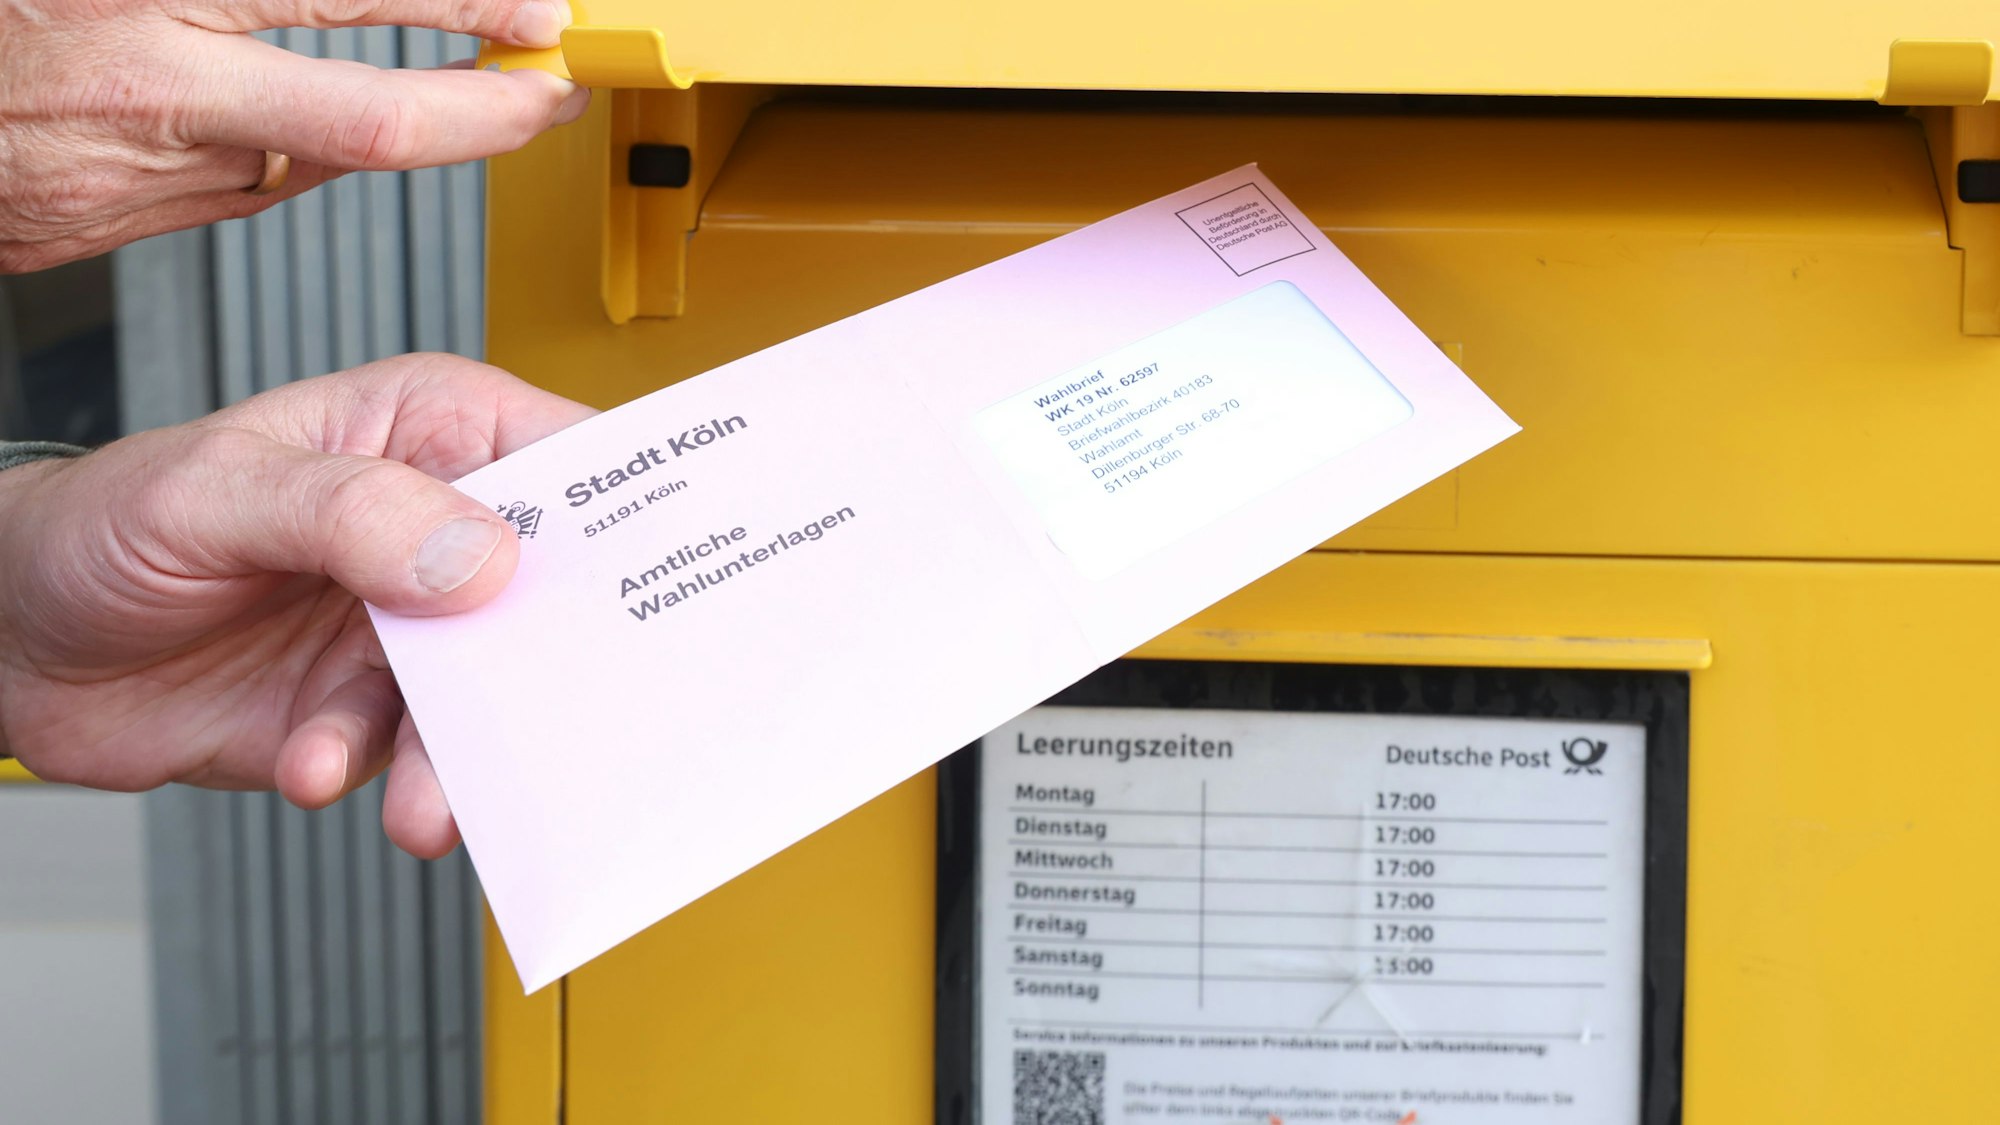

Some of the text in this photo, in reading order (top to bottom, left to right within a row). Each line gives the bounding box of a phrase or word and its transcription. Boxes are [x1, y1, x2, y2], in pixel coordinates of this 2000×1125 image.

[1202, 201, 1259, 226] Unentgeltliche
[1209, 207, 1267, 234] Beförderung in
[1208, 212, 1281, 244] Deutschland durch
[1216, 220, 1288, 251] Deutsche Post AG
[1034, 370, 1105, 409] Wahlbrief
[1045, 362, 1160, 423] WK 19 Nr. 62597
[1057, 397, 1129, 437] Stadt Köln
[1068, 374, 1213, 451] Briefwahlbezirk 40183
[1079, 427, 1144, 465] Wahlamt
[1091, 398, 1240, 480] Dillenburger Str. 68-70
[565, 415, 748, 508] Stadt Köln
[1103, 448, 1184, 495] 51194 Köln
[583, 479, 688, 538] 51191 Köln
[620, 524, 747, 599] Amtliche
[627, 506, 856, 622] Wahlunterlagen
[1017, 732, 1233, 762] Leerungszeiten
[1386, 745, 1551, 768] Deutsche Post
[1015, 784, 1095, 806] Montag
[1375, 793, 1436, 811] 17:00
[1015, 817, 1107, 839] Dienstag
[1375, 826, 1435, 844] 17:00
[1014, 850, 1113, 869] Mittwoch
[1375, 859, 1435, 877] 17:00
[1014, 881, 1135, 906] Donnerstag
[1374, 892, 1434, 910] 17:00
[1014, 914, 1087, 937] Freitag
[1374, 925, 1434, 943] 17:00
[1014, 946, 1103, 969] Samstag
[1014, 979, 1099, 1002] Sonntag
